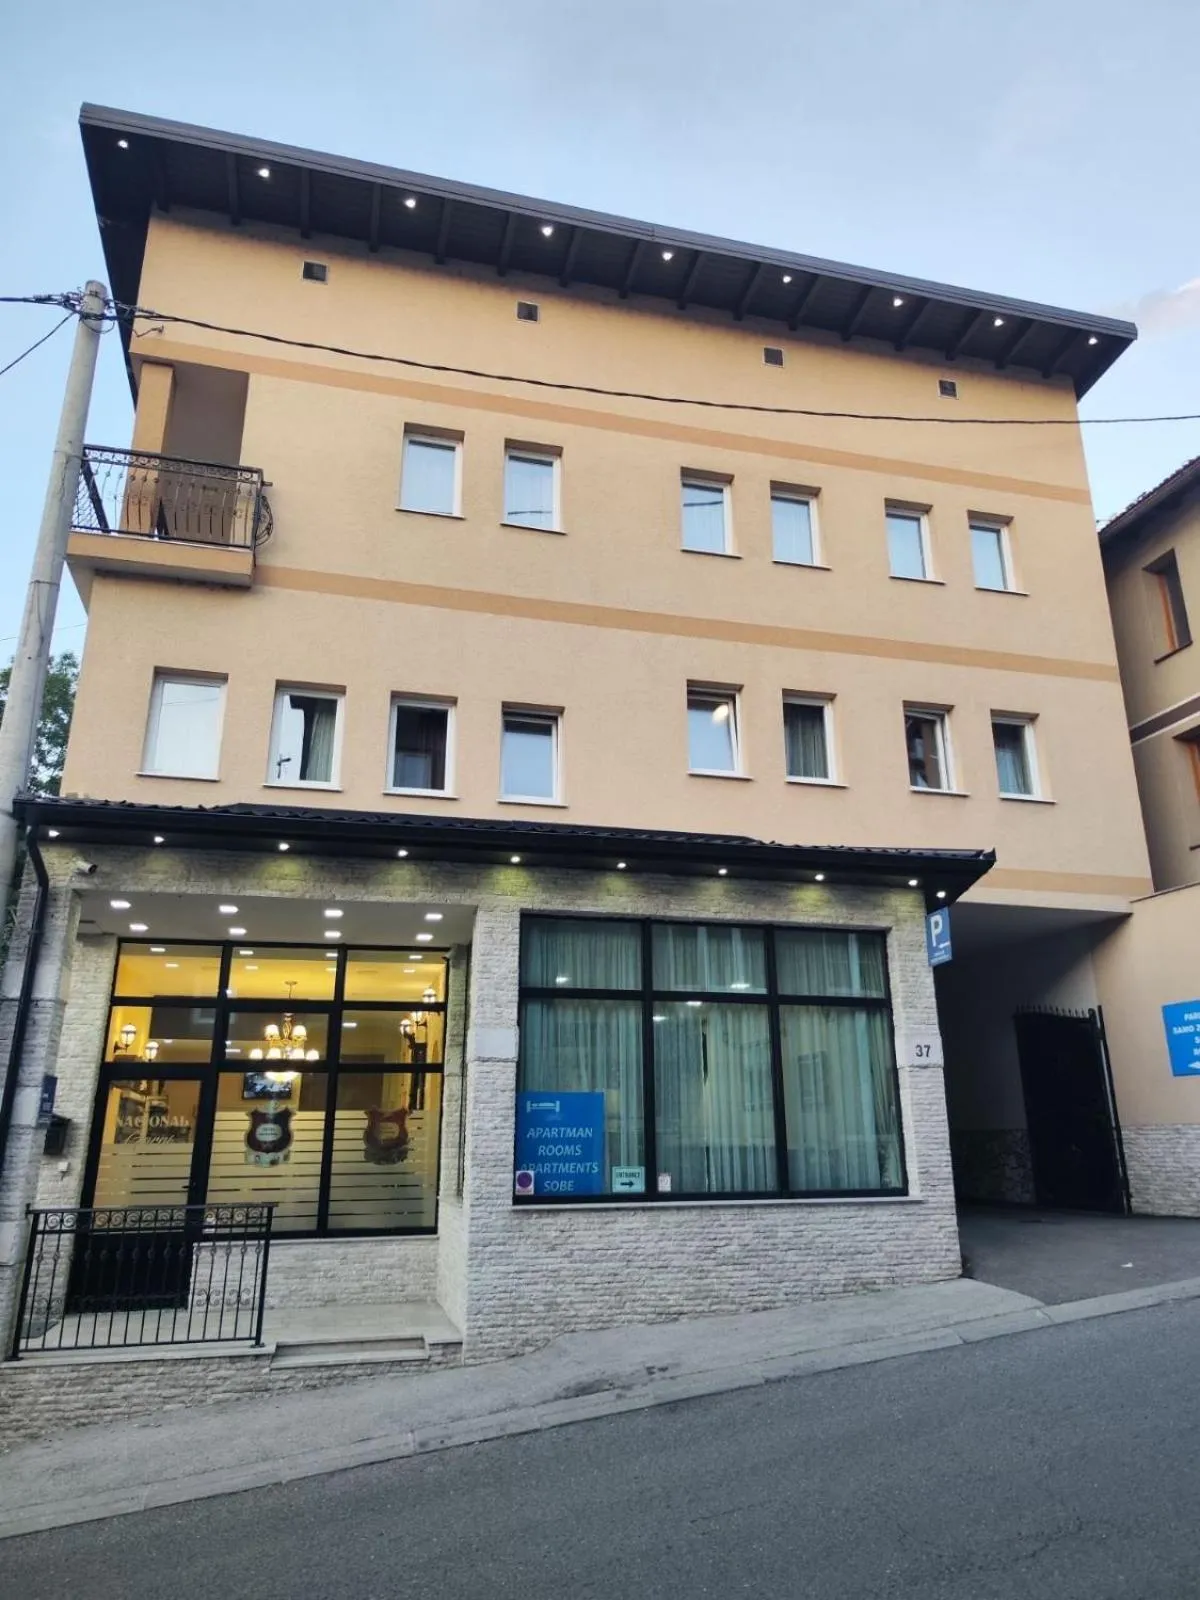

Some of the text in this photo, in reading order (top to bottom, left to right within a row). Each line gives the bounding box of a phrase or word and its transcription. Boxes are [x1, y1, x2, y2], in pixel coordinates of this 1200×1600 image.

[931, 915, 942, 947] P
[915, 1044, 931, 1058] 37
[526, 1127, 593, 1139] APARTMAN
[538, 1144, 582, 1156] ROOMS
[521, 1161, 599, 1174] APARTMENTS
[543, 1180, 575, 1192] SOBE
